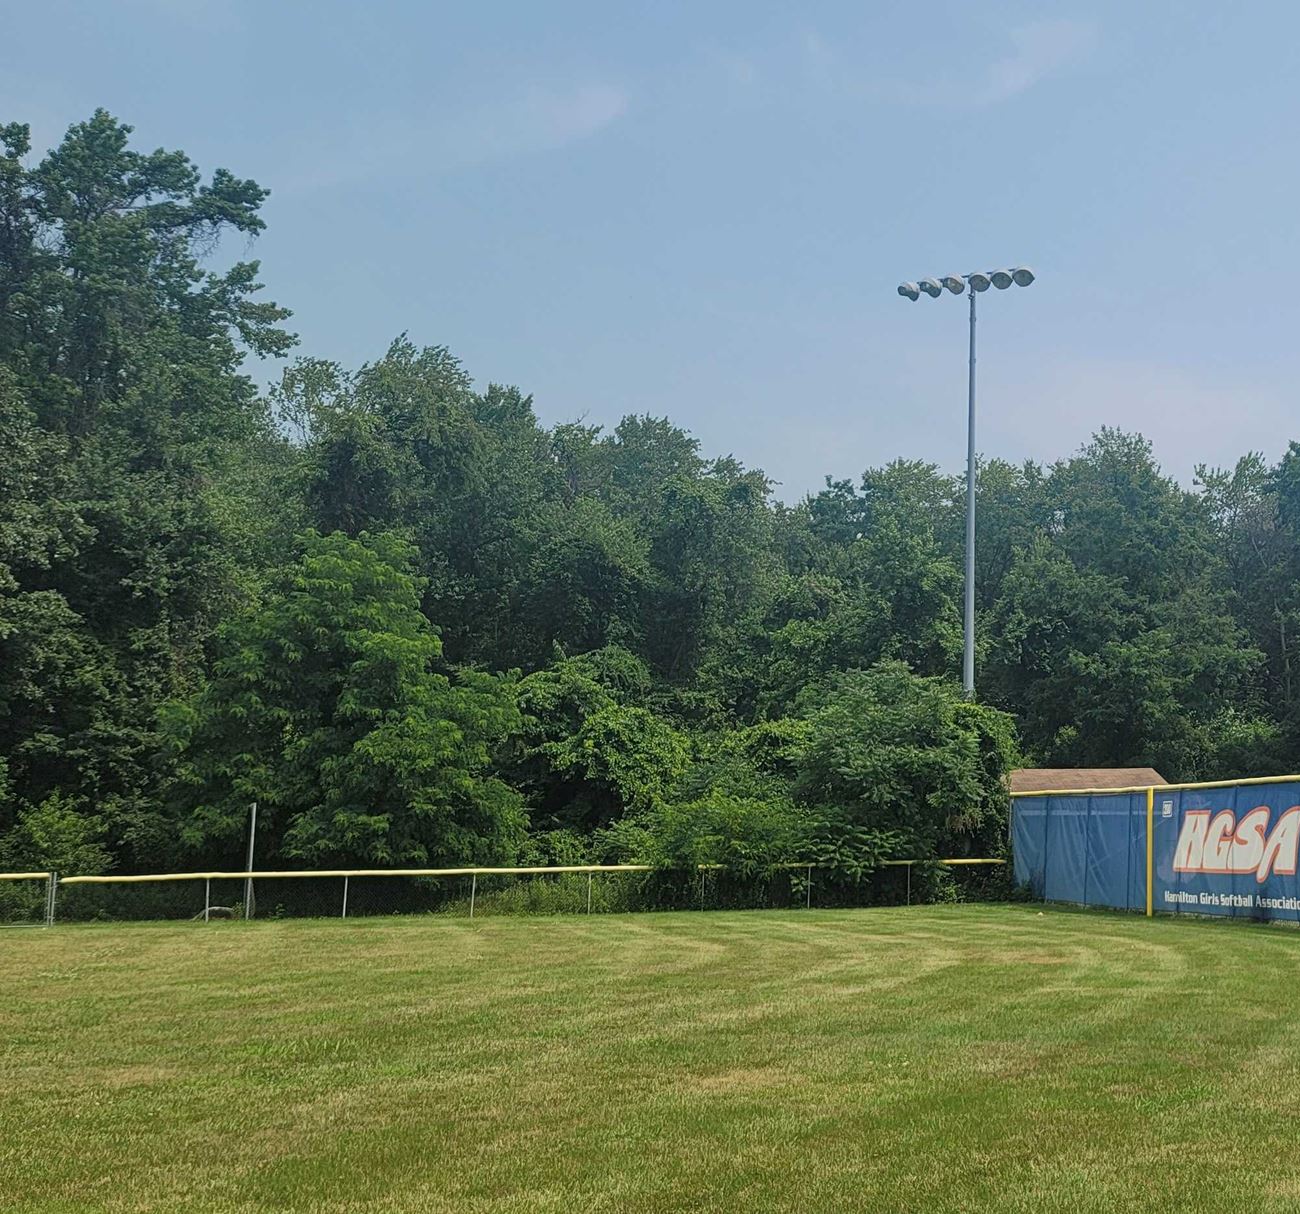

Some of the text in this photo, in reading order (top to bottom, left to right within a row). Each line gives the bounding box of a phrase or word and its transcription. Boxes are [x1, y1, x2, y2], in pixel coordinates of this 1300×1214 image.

[1164, 890, 1198, 905] Hamilton
[1200, 892, 1219, 906] Girls
[1220, 894, 1253, 907] Softball
